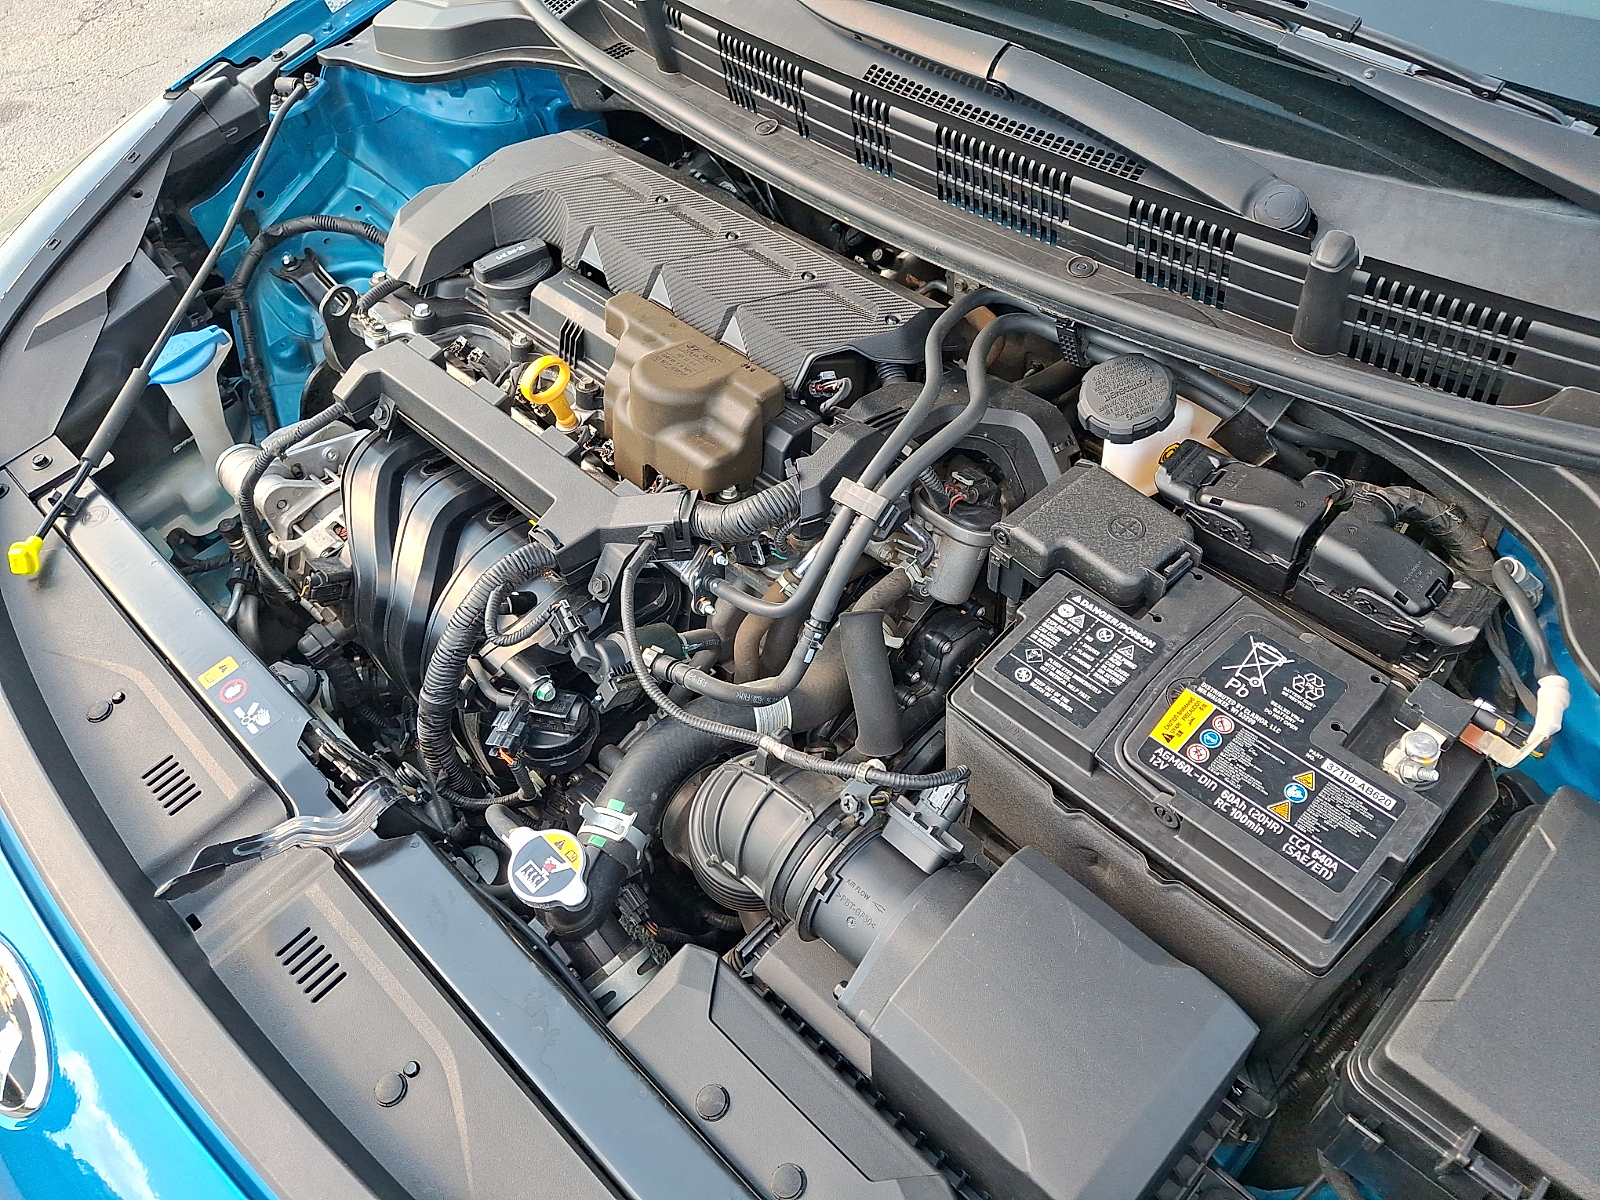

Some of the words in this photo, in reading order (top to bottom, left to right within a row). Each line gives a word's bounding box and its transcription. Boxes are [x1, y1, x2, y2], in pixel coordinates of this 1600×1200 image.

[1078, 599, 1158, 649] DANGER/POISON
[1195, 687, 1231, 710] MILWAUKEE,
[1229, 707, 1240, 715] WI
[1223, 676, 1253, 699] Pb
[1200, 682, 1237, 706] DISTRIBUTED
[1235, 703, 1245, 711] BY
[1269, 724, 1283, 734] LLC
[1271, 707, 1297, 724] BATTERY
[1271, 713, 1284, 722] NOT
[1282, 720, 1299, 731] OPEN
[1307, 748, 1325, 761] PART
[1148, 754, 1169, 772] 12V
[1212, 797, 1232, 814] RC
[1229, 808, 1267, 837] 100min
[1324, 762, 1394, 807] 37110-AB620
[1219, 789, 1249, 812] 60Ah
[1246, 806, 1285, 836] (20HR)
[1287, 834, 1312, 854] CCA
[1310, 849, 1341, 873] 640A
[845, 878, 856, 888] AIR
[854, 885, 872, 901] FLOW
